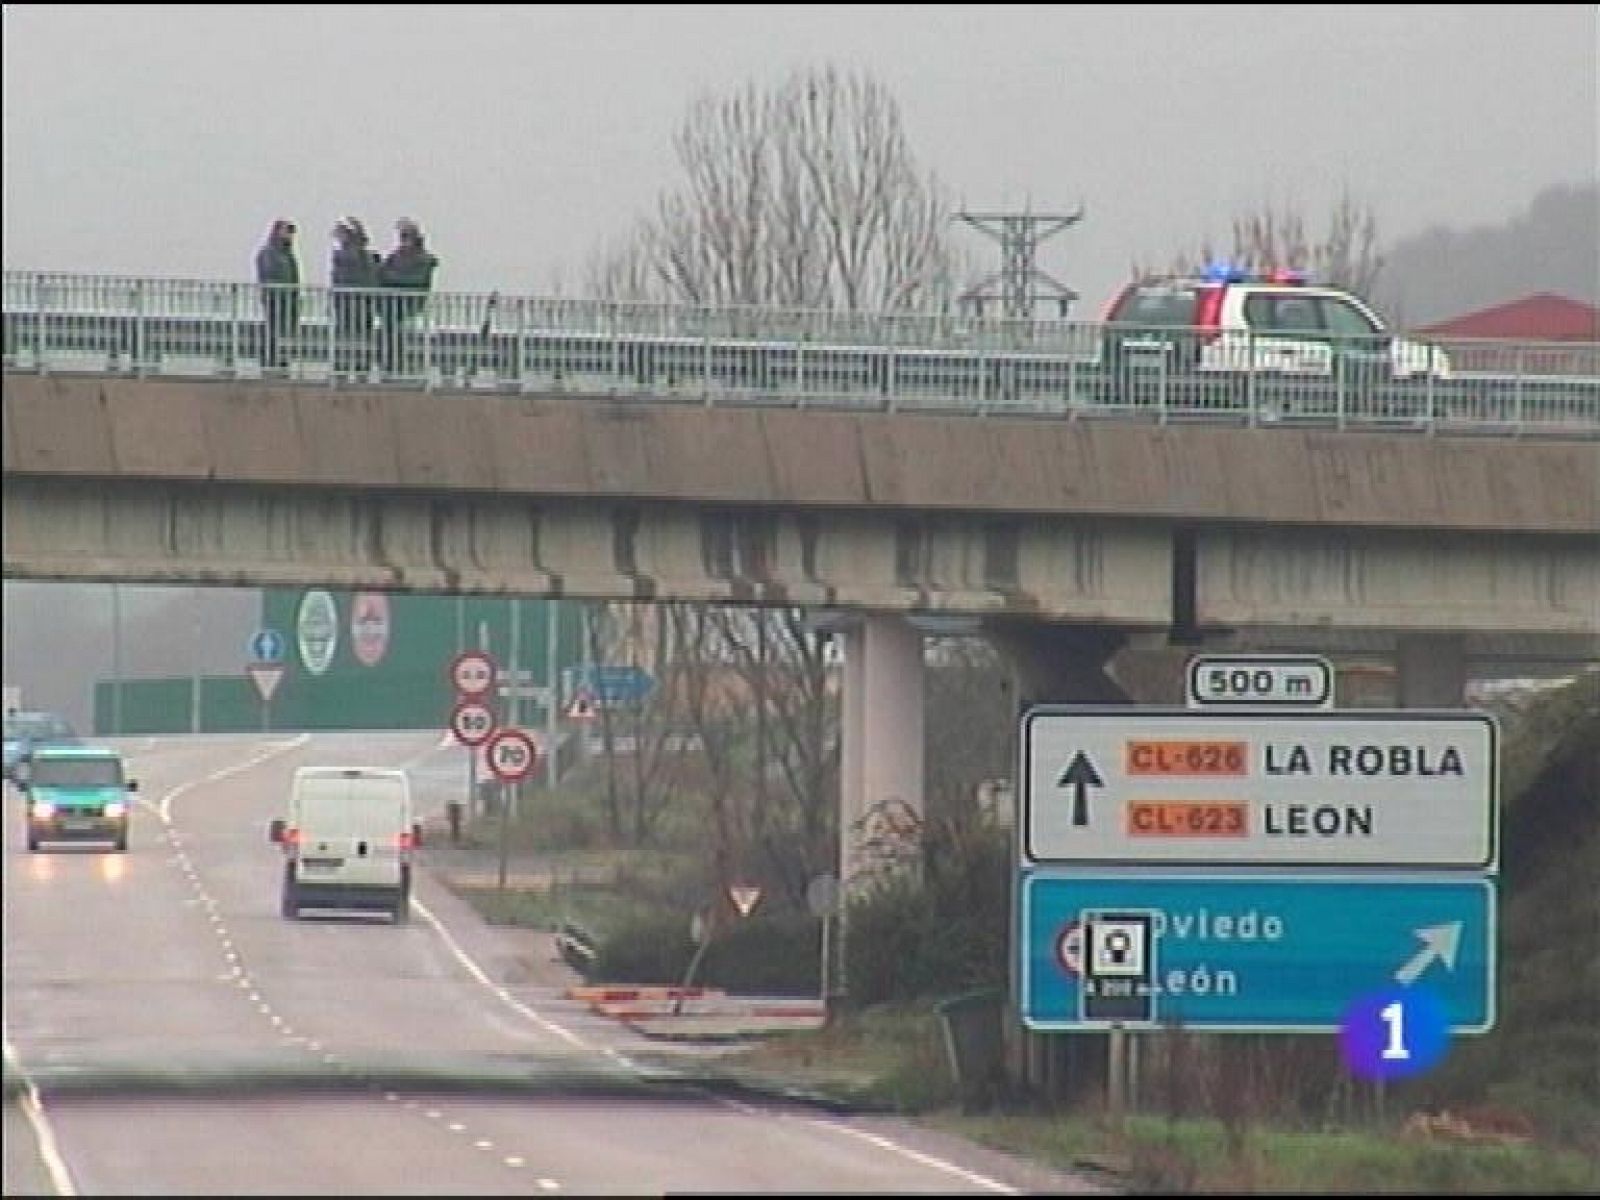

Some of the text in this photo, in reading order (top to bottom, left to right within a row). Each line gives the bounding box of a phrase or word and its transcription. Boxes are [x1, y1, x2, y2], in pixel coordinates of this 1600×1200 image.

[1209, 670, 1312, 694] 500 m
[499, 744, 527, 765] 70
[1264, 743, 1311, 776] LA
[1328, 743, 1465, 776] ROBLA
[1264, 802, 1374, 836] LEON
[1157, 961, 1237, 998] eón
